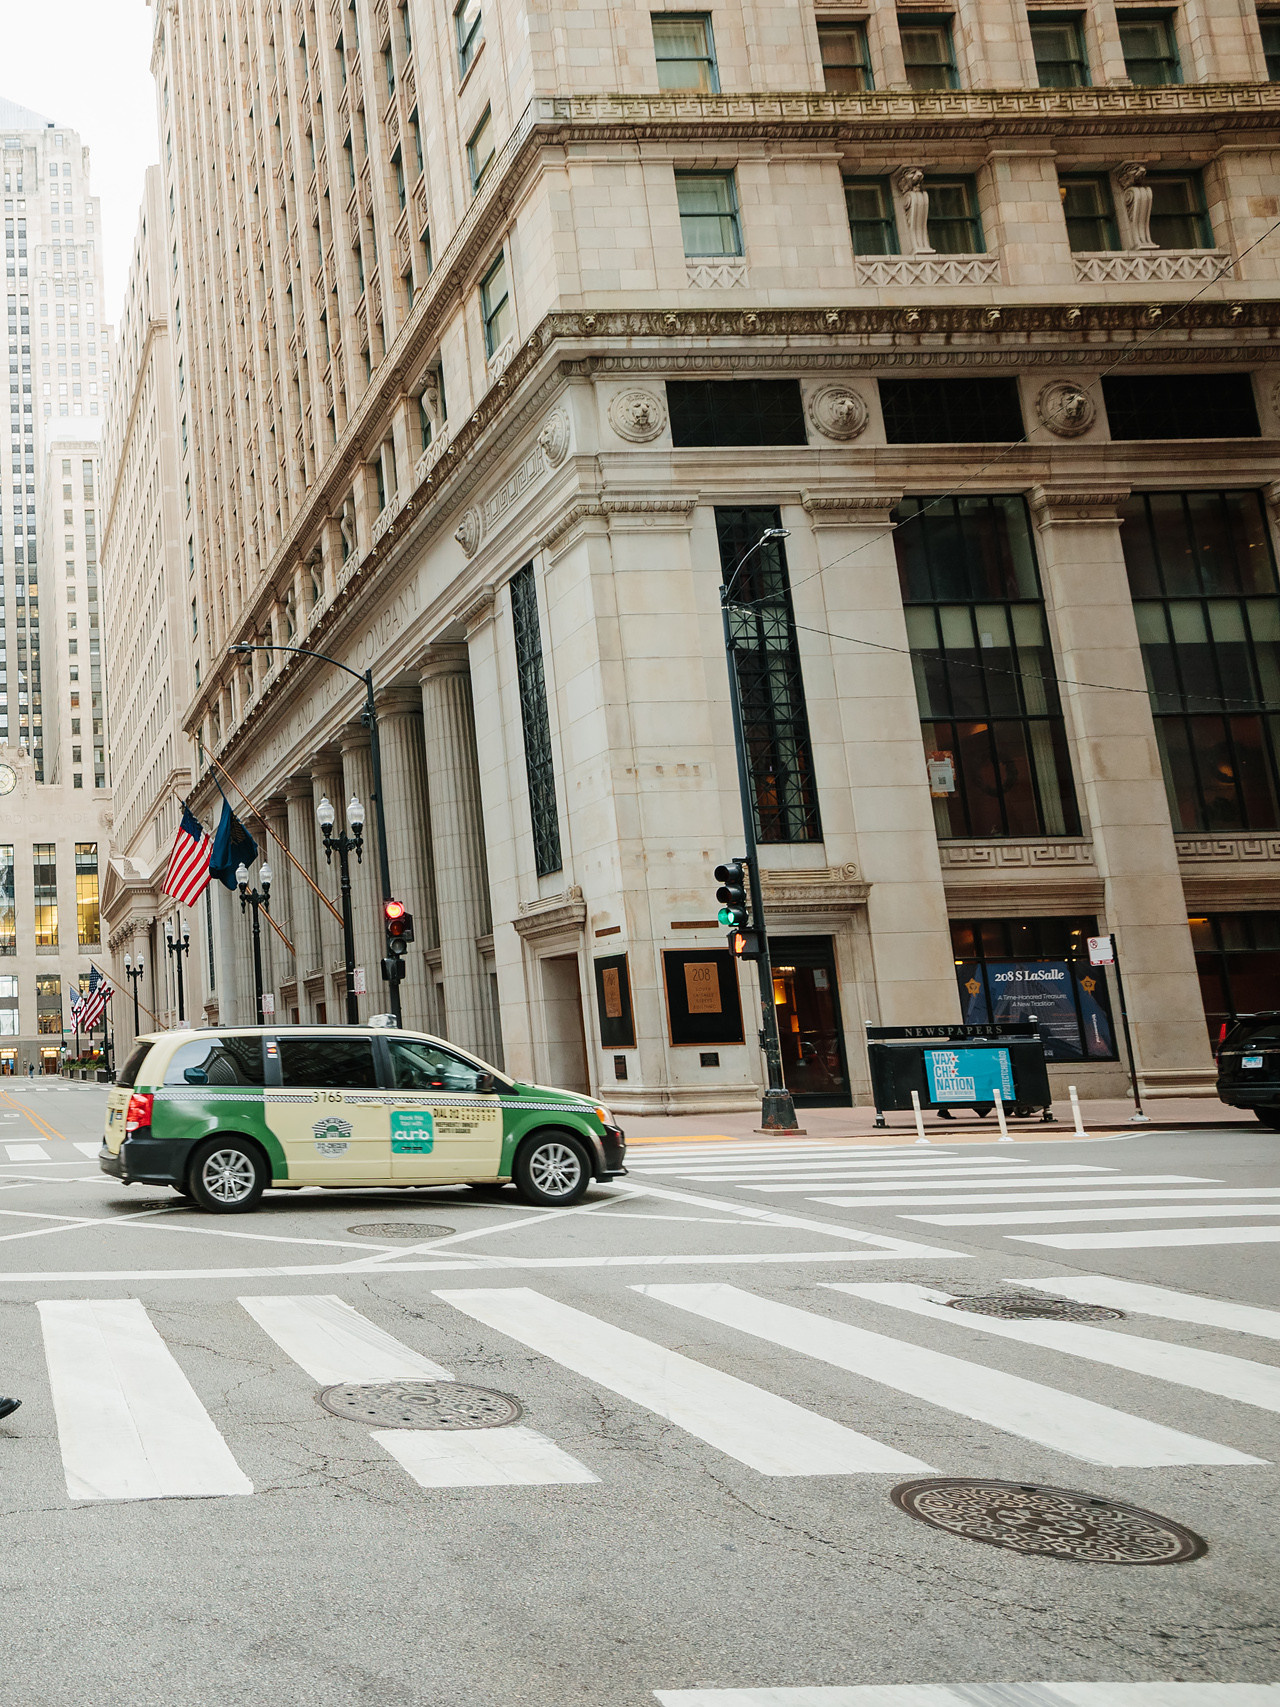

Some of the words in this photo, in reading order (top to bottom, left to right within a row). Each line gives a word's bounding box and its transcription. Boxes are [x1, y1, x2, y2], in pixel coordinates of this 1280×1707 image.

[296, 697, 315, 738] AND
[319, 655, 351, 710] TRUST
[356, 574, 418, 670] COMPANY
[692, 968, 711, 982] 208
[995, 971, 1014, 982] 208
[1016, 970, 1023, 981] S
[1025, 969, 1065, 981] LaSalle
[904, 1025, 1003, 1037] NEWSPAPERS
[933, 1053, 954, 1065] VAX
[936, 1078, 974, 1091] NATION
[313, 1091, 343, 1103] 3765
[433, 1108, 447, 1118] DIAL
[394, 1129, 430, 1141] curb
